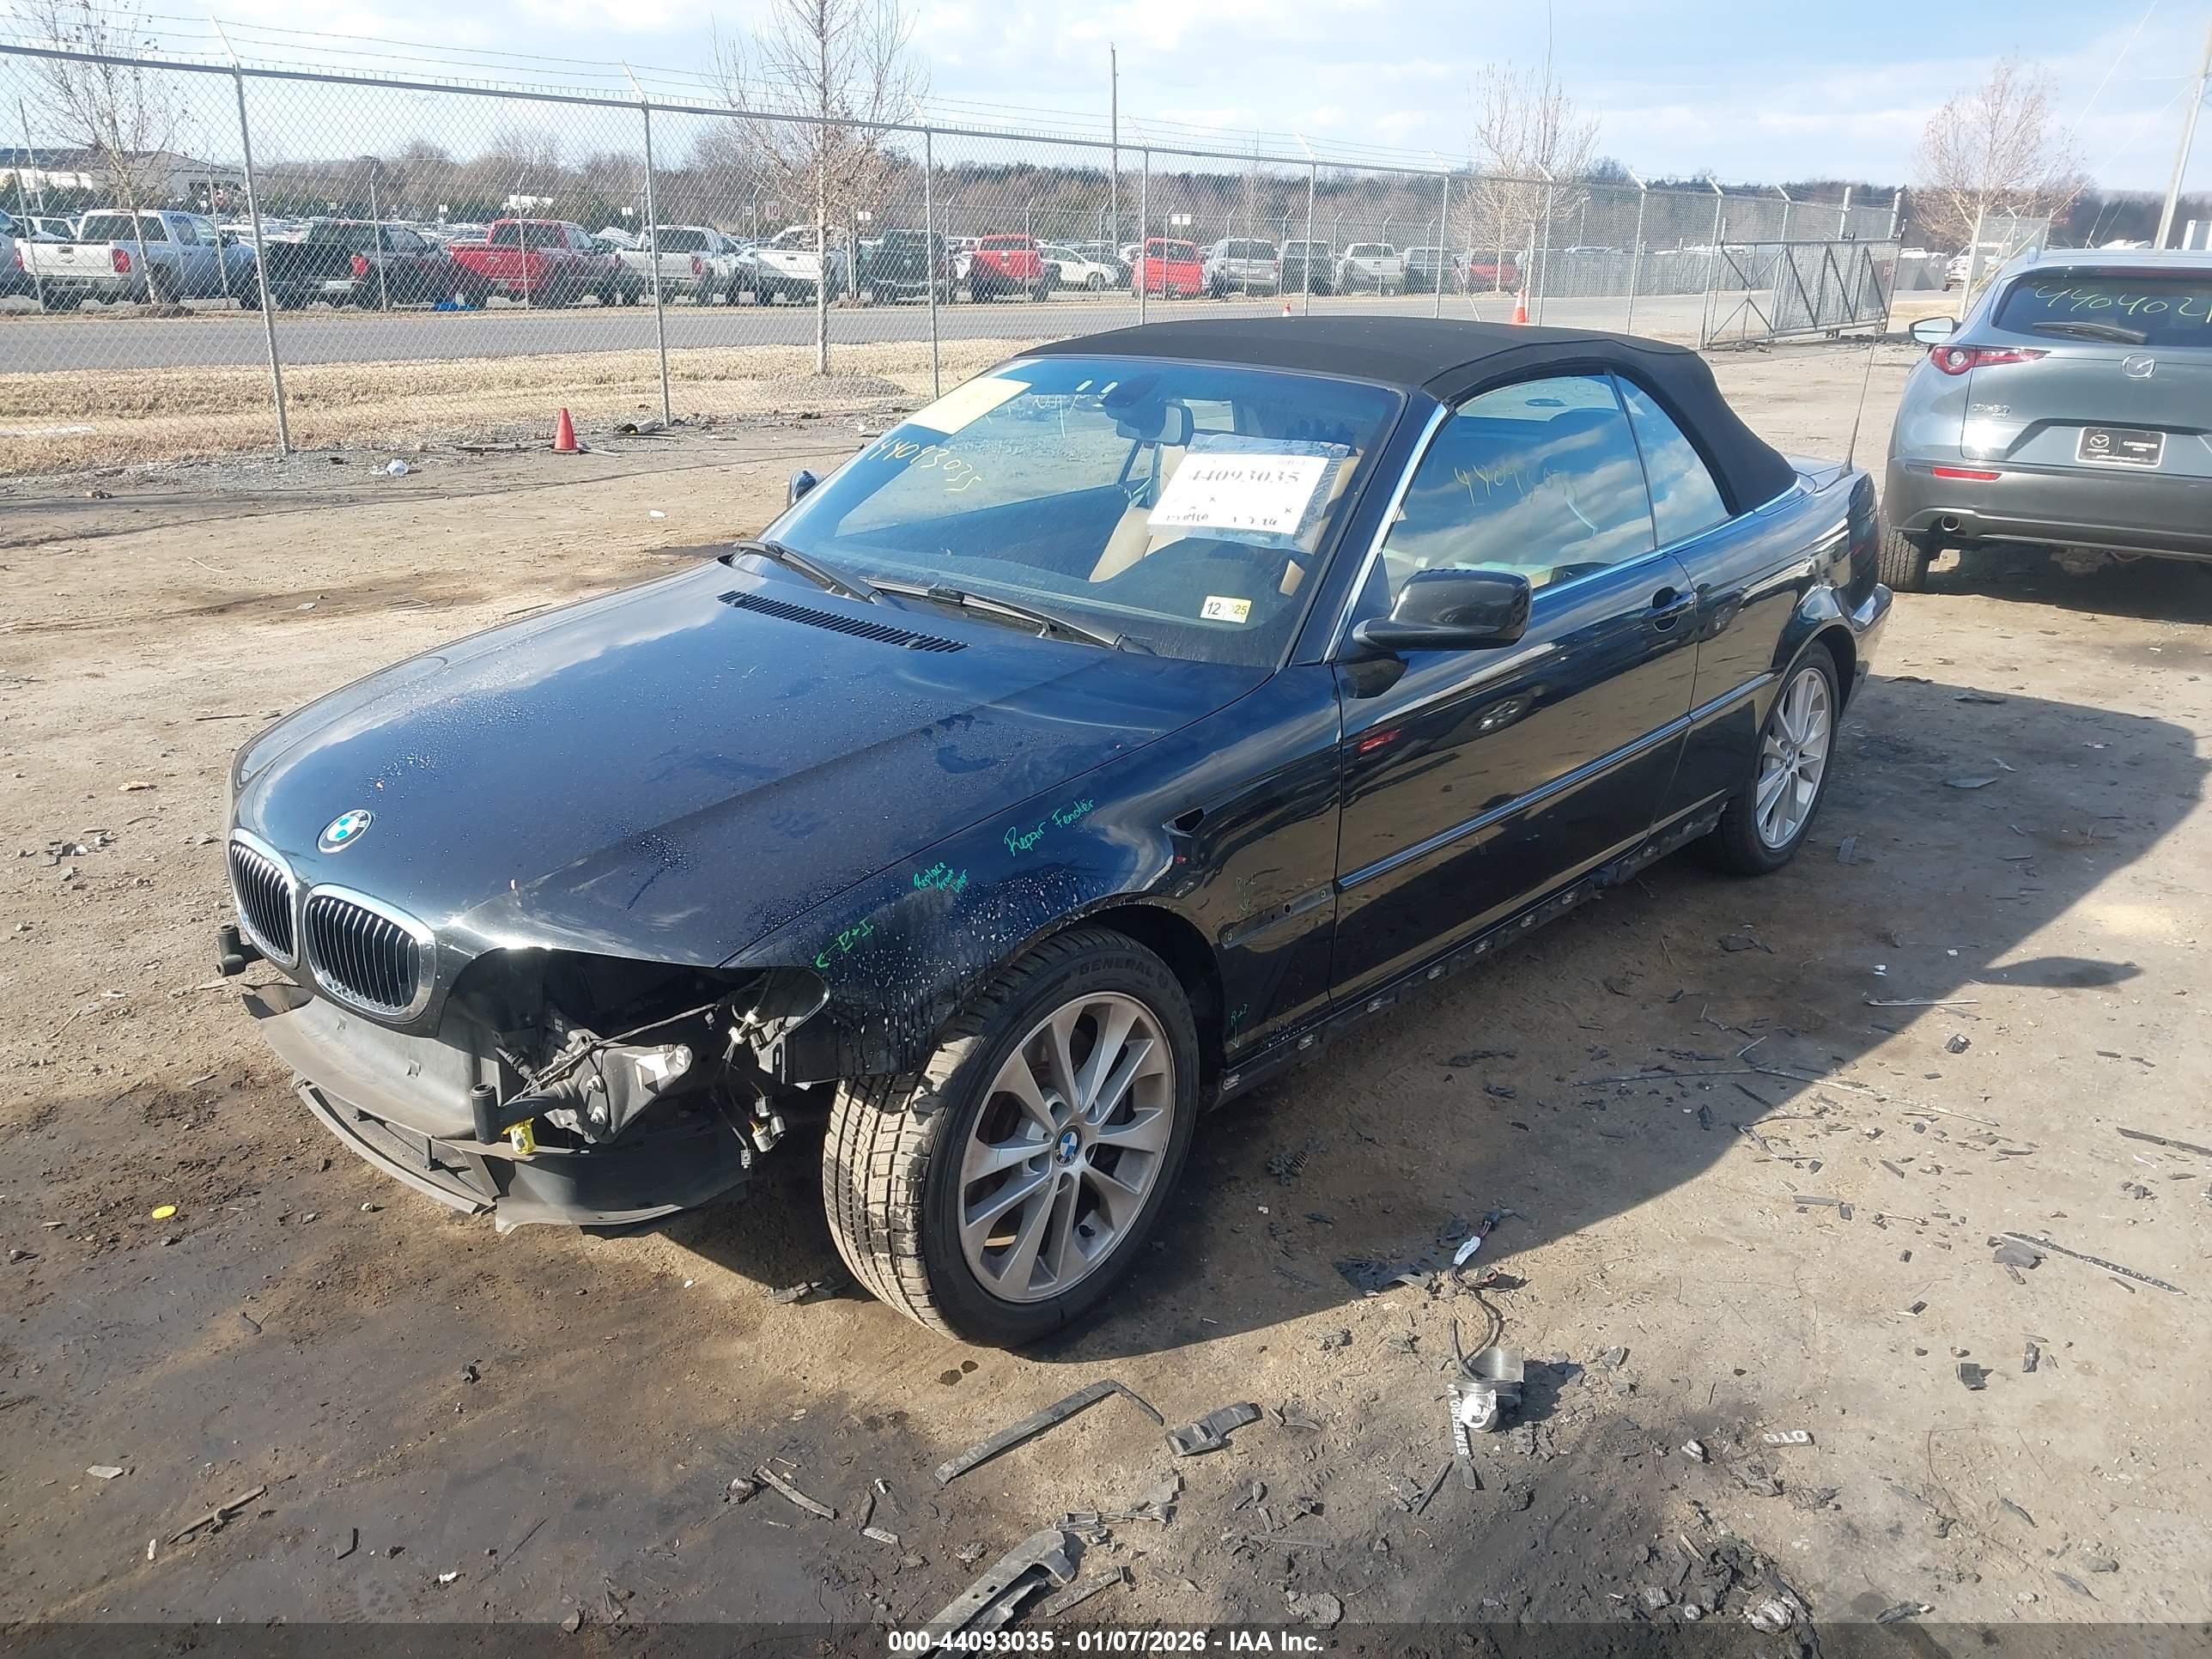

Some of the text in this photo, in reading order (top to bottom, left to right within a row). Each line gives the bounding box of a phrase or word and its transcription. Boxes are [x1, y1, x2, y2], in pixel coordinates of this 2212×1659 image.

[1207, 601, 1248, 616] 12 25
[1004, 798, 1095, 857] Repair Fender
